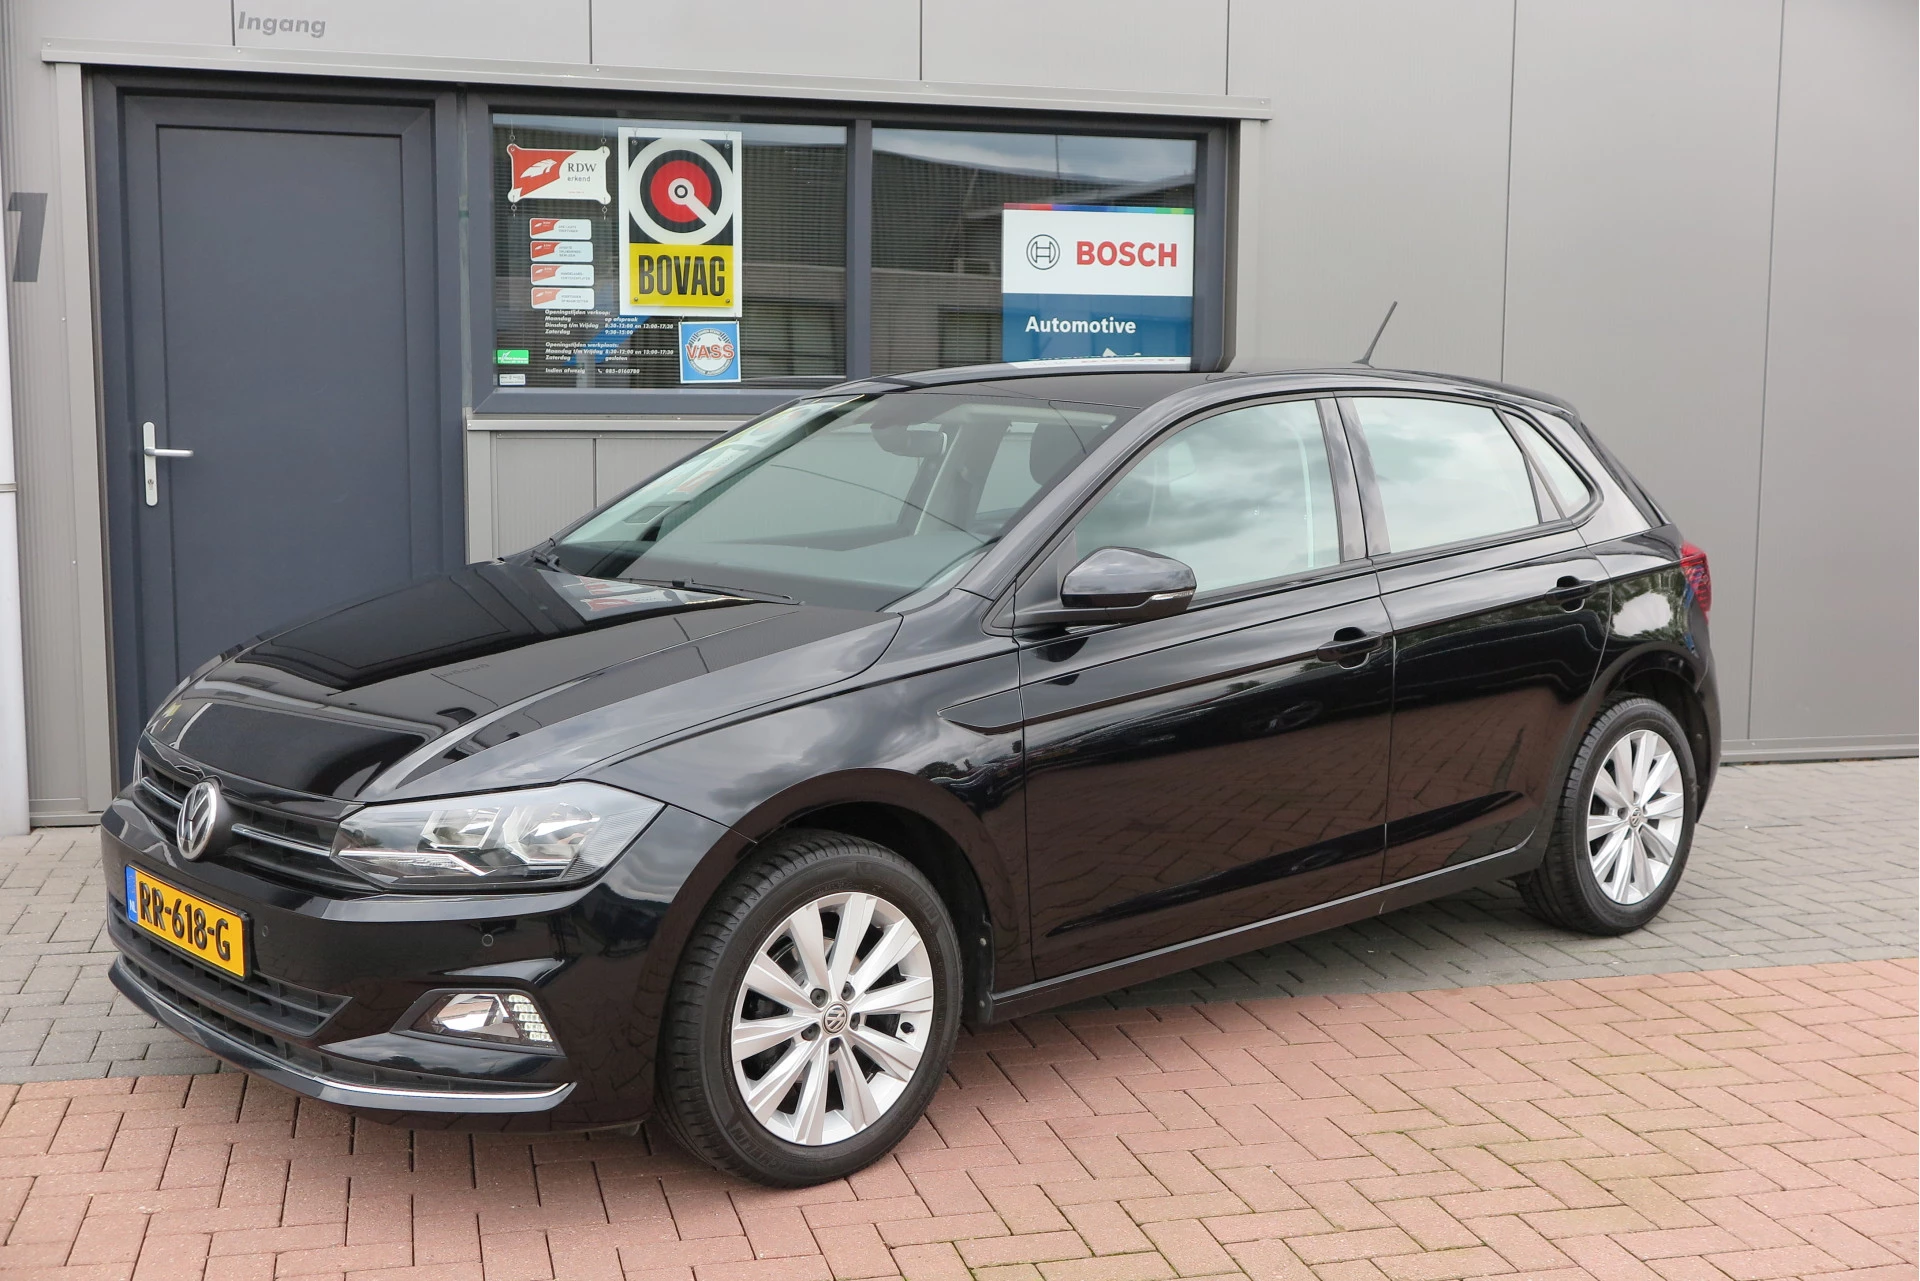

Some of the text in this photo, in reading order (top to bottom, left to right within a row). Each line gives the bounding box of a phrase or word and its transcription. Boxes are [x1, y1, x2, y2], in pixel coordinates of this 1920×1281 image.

[238, 11, 326, 38] Ingang
[567, 163, 597, 172] RDW
[7, 192, 48, 282] 1
[1076, 241, 1178, 267] BOSCH
[638, 255, 725, 296] BOVAG
[1025, 316, 1137, 334] Automotive
[686, 344, 735, 359] VASS
[129, 881, 231, 961] NL RR-618-G
